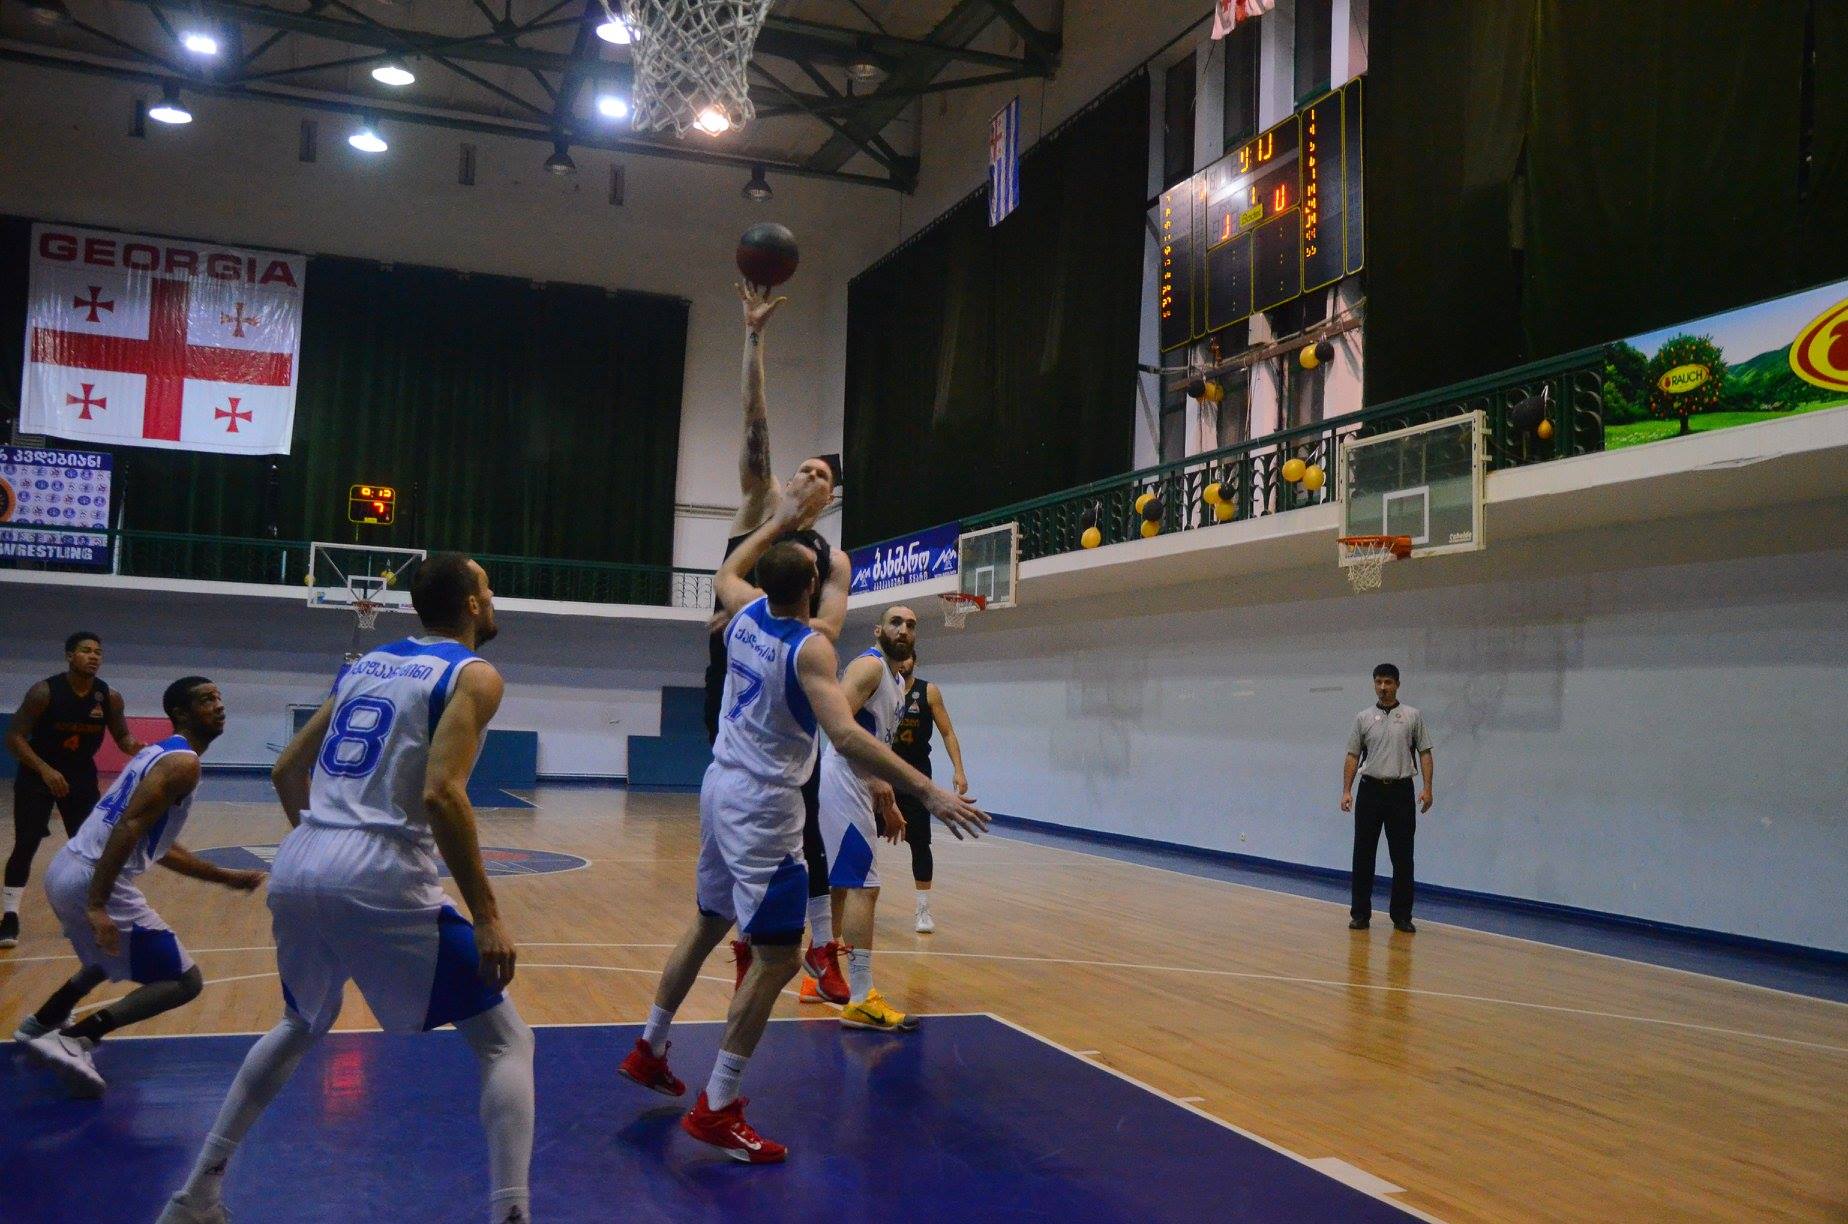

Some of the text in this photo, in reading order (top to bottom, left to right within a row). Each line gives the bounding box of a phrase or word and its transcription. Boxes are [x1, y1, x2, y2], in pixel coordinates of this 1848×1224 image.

[39, 233, 297, 287] GEORGIA
[1671, 368, 1703, 386] RAUCH
[0, 543, 93, 560] WRESTLING
[872, 540, 931, 581] ბახმარო
[724, 659, 764, 722] 7
[319, 694, 396, 778] 8
